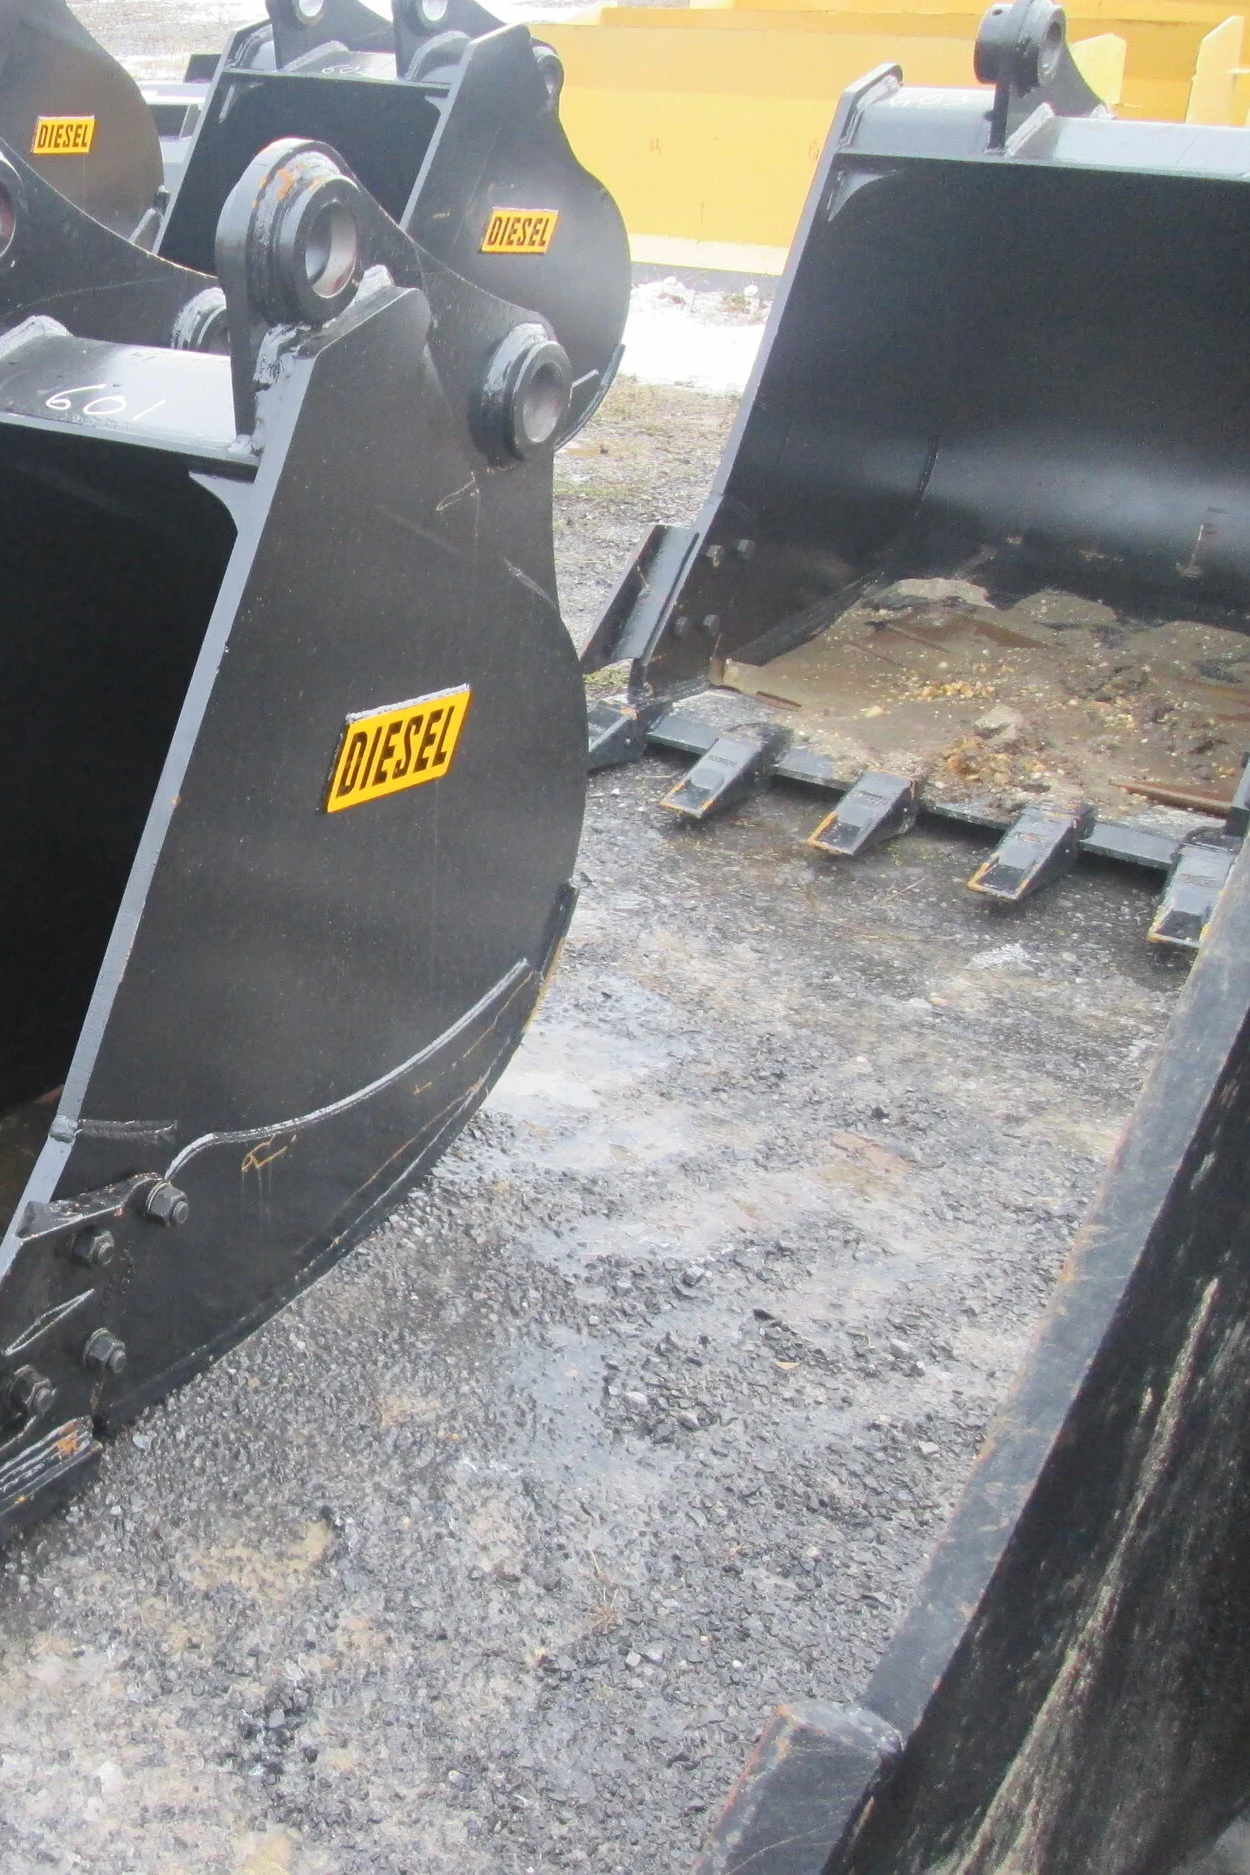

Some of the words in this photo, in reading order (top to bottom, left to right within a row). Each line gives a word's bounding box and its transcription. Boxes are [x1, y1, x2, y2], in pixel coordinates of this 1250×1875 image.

[37, 123, 88, 148] DIESEL
[487, 215, 550, 247] DIESEL
[46, 383, 166, 421] 601
[335, 705, 455, 799] DIESEL
